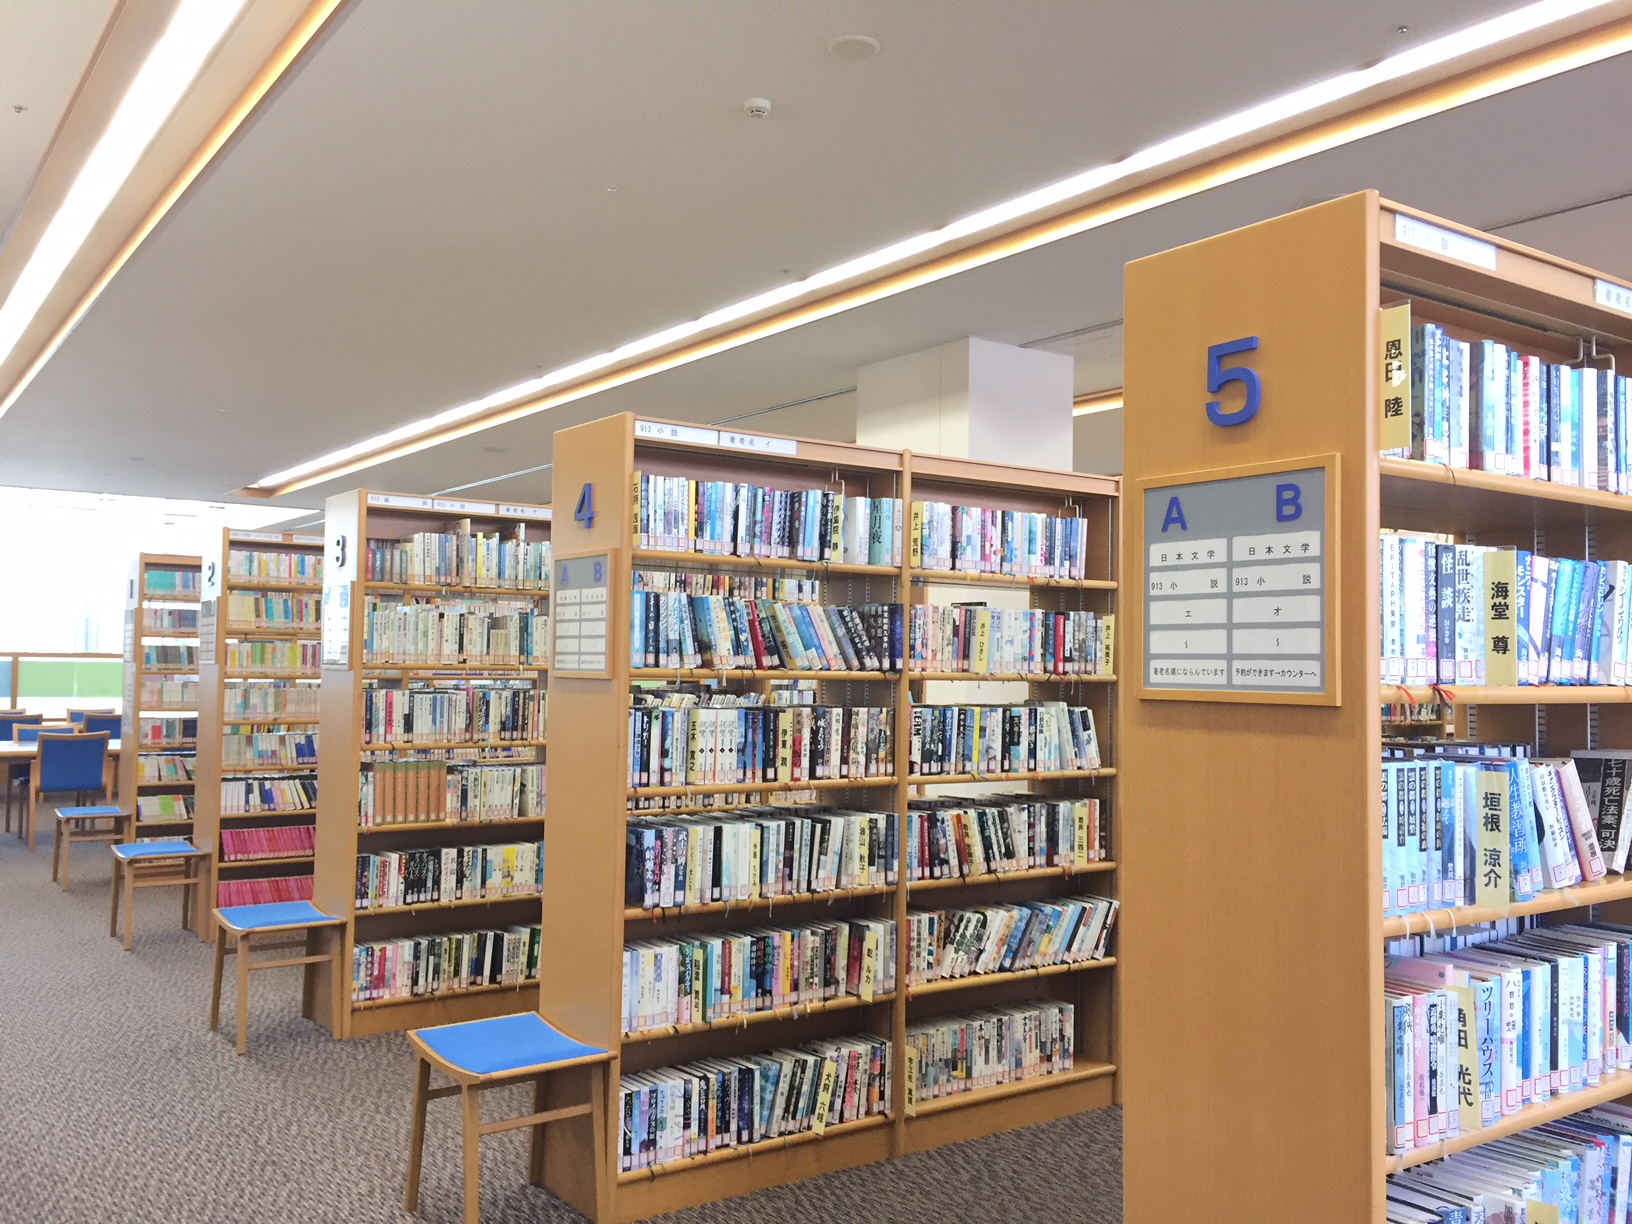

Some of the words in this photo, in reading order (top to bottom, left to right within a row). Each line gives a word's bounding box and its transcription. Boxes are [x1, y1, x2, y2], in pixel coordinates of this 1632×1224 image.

[1206, 336, 1262, 427] 5
[1384, 397, 1404, 419] 陸
[640, 424, 652, 433] 913
[574, 482, 595, 529] 4
[1161, 496, 1189, 533] A
[1276, 483, 1303, 523] B
[832, 504, 840, 535] 伊集院
[871, 499, 883, 545] 星月夜
[912, 511, 919, 531] 井上
[832, 542, 839, 552] 静
[912, 537, 919, 557] 荒野
[1161, 549, 1215, 562] 日本文学
[1248, 542, 1310, 556] 日本文学
[561, 564, 569, 586] A
[593, 561, 603, 583] B
[1235, 577, 1249, 587] 913
[1441, 551, 1454, 610] 怪談
[1151, 582, 1163, 591] 913
[1455, 549, 1471, 624] 乱世疾走
[1517, 565, 1526, 619] モンスター
[1597, 565, 1606, 613] ガンコロリン
[1273, 606, 1282, 617] オ
[1491, 581, 1510, 621] 海堂
[670, 597, 680, 633] ノボさん
[980, 623, 986, 637] 井上
[1104, 625, 1111, 640] 井上
[1491, 635, 1510, 656] 尊
[1153, 667, 1226, 677] 著者名順にならんでいます
[690, 721, 697, 743] 五木
[780, 728, 788, 750] 伊東
[689, 750, 696, 772] 寛之
[780, 756, 788, 767] 潤
[1482, 791, 1502, 834] 垣根
[1508, 767, 1528, 854] 人生教習所
[1600, 759, 1623, 850] 七十歳死亡法案、可決
[859, 826, 866, 847] 絲山
[859, 854, 866, 874] 秋子
[1483, 847, 1502, 890] 涼介
[866, 947, 873, 959] 乾
[865, 965, 871, 985] ルカ
[1481, 985, 1495, 1079] ツリーハウス
[822, 1072, 832, 1095] 犬飼
